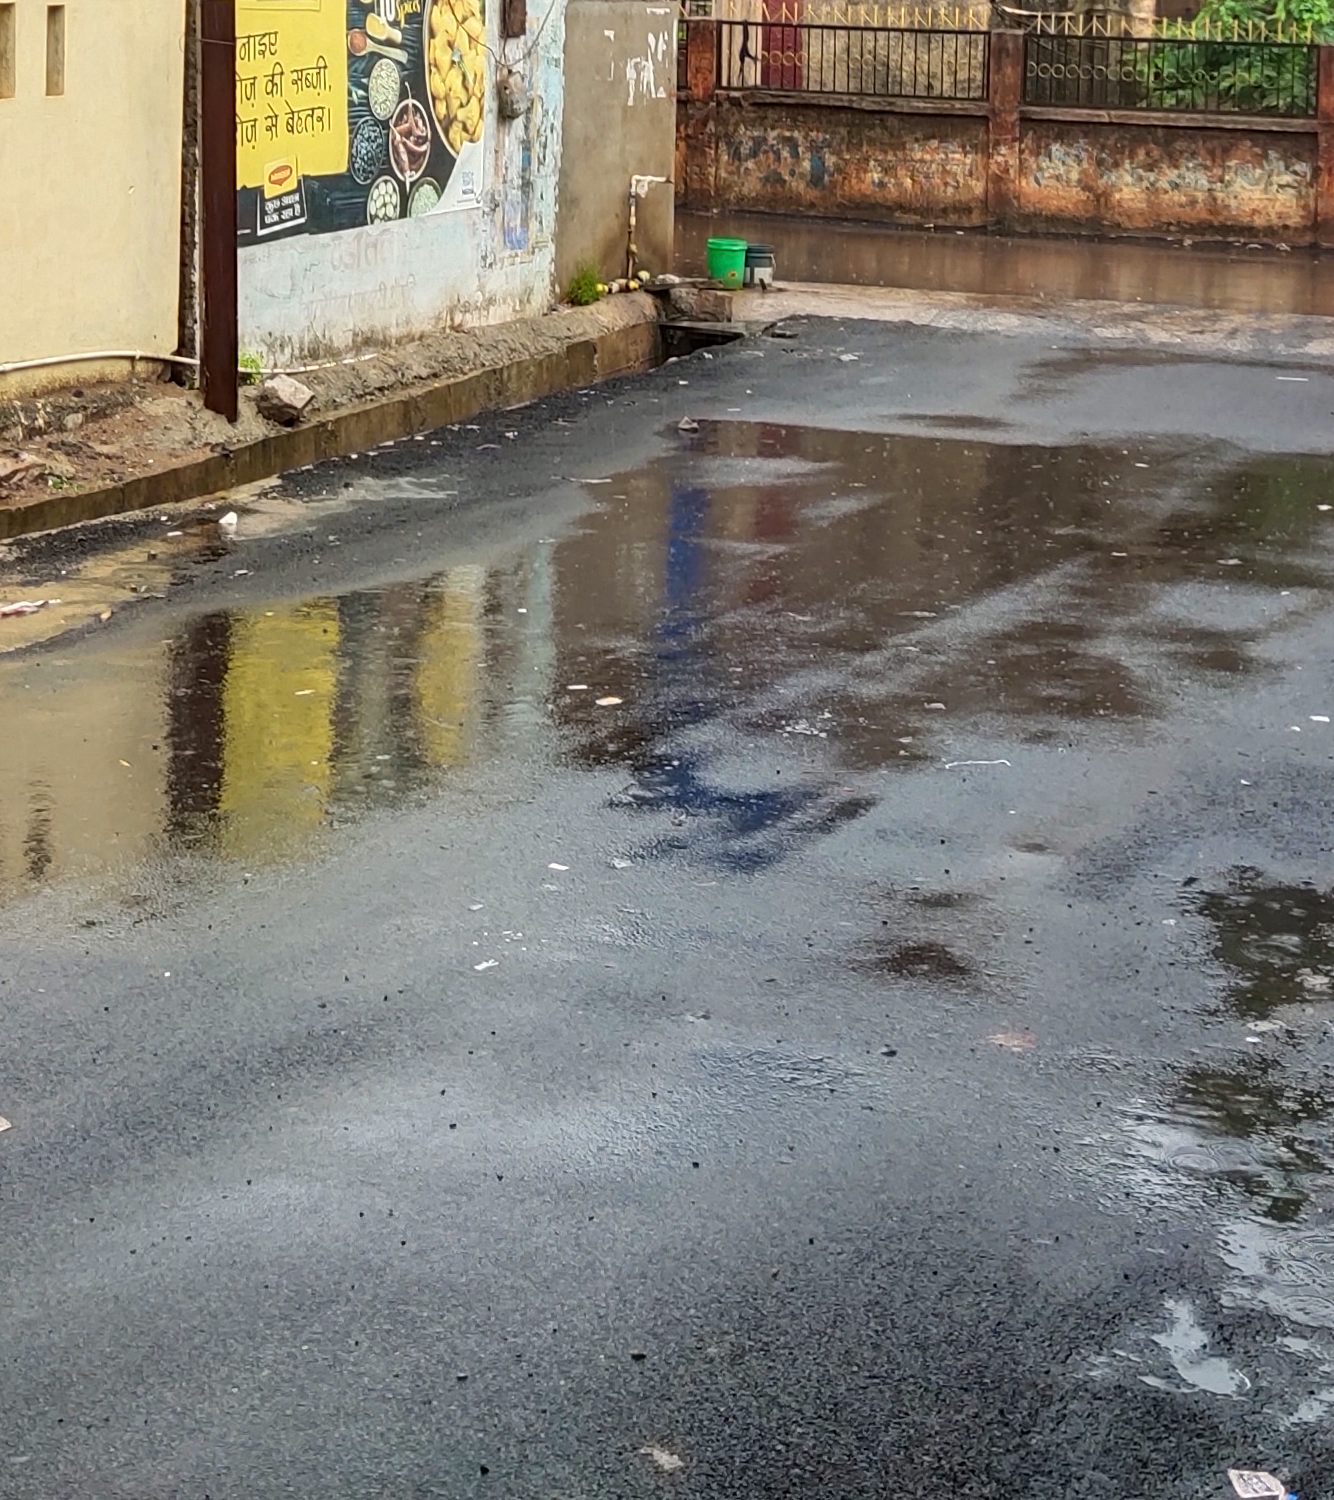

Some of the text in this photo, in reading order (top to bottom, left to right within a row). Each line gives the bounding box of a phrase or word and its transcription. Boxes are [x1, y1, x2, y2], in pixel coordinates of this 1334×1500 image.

[235, 30, 278, 62] नाइए
[263, 61, 285, 98] की
[264, 102, 279, 141] से
